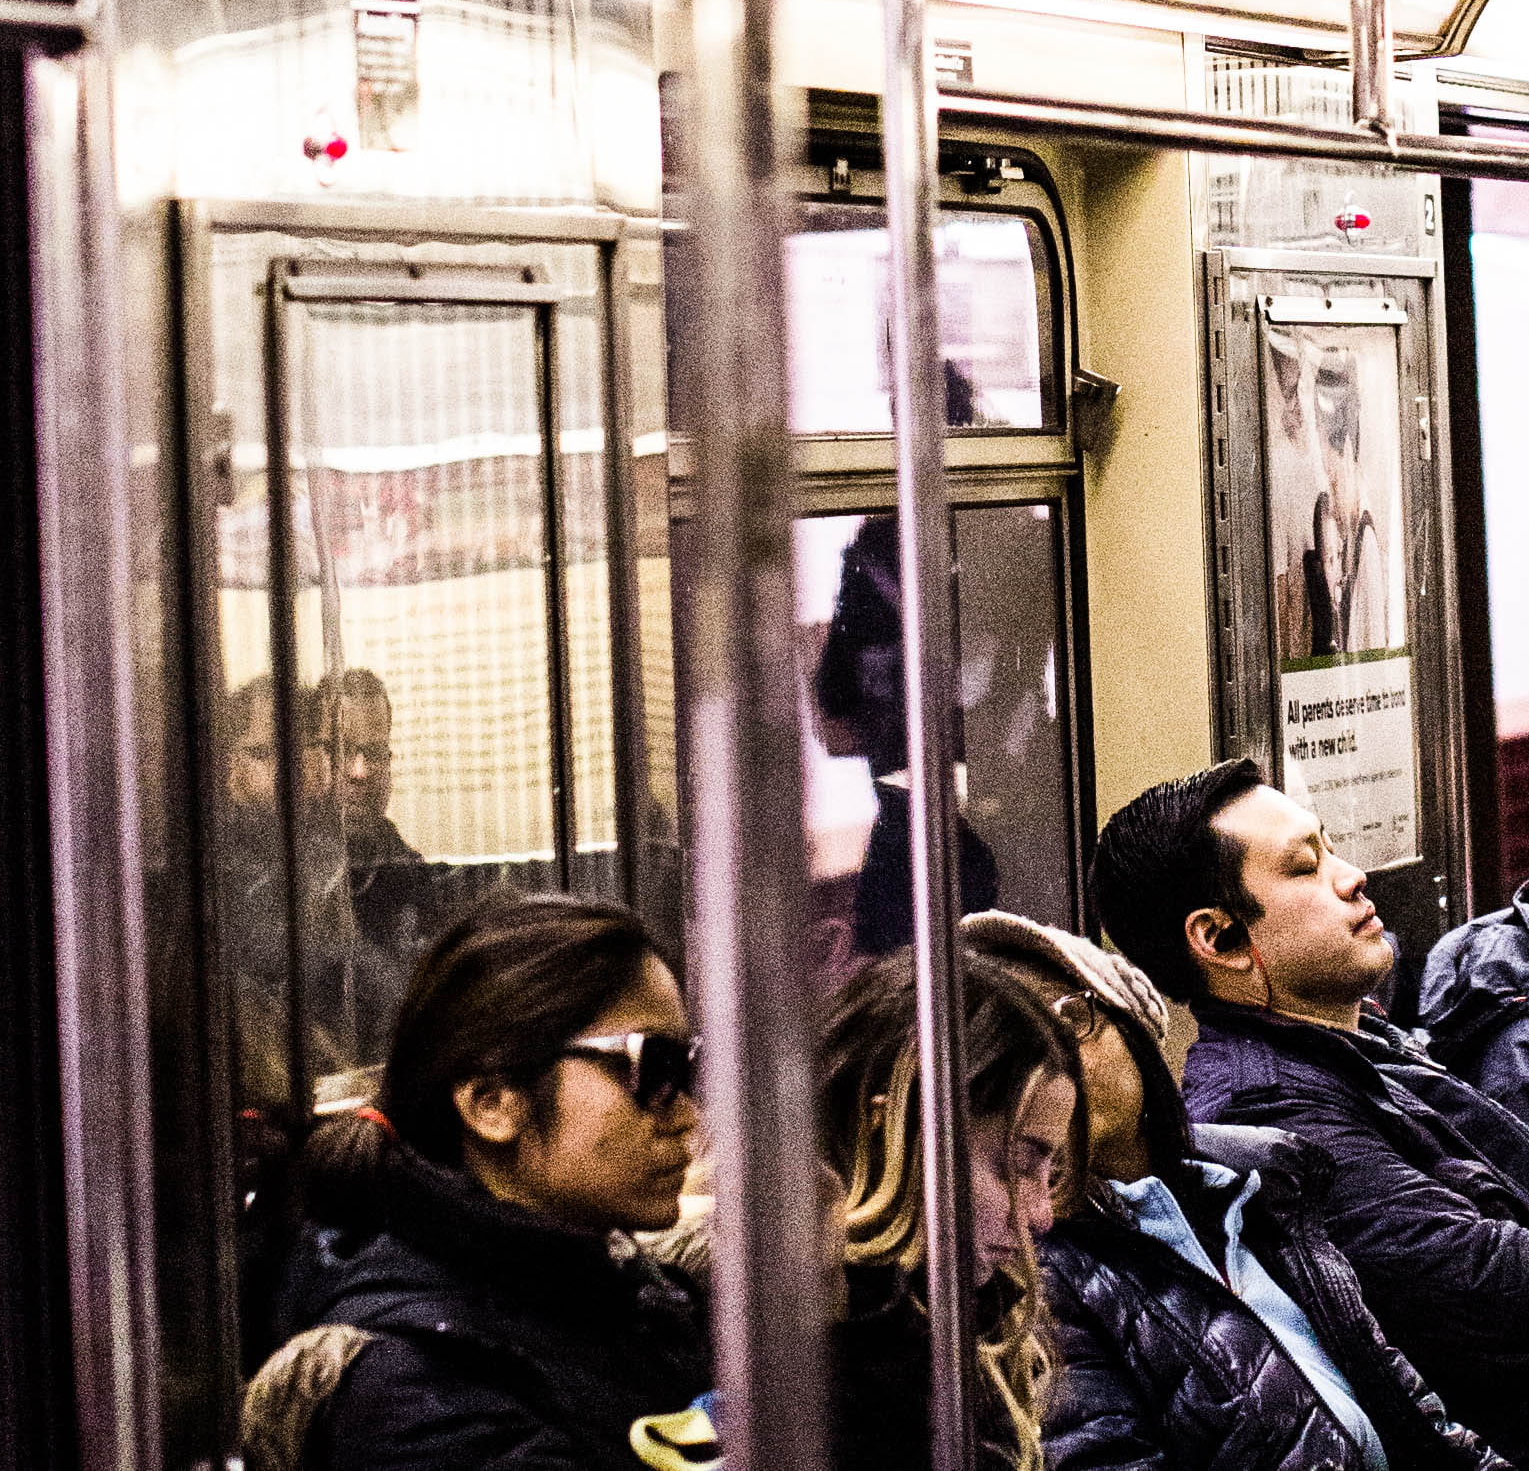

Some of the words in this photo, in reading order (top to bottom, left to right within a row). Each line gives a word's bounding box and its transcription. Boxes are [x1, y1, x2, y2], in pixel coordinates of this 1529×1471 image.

[1287, 699, 1300, 725] All
[1302, 698, 1334, 729] parents
[1335, 695, 1365, 718] deserve
[1365, 688, 1382, 713] time
[1380, 688, 1389, 710] to
[1390, 683, 1406, 709] bond
[1288, 736, 1310, 761] with
[1311, 741, 1317, 759] a
[1318, 738, 1336, 757] new
